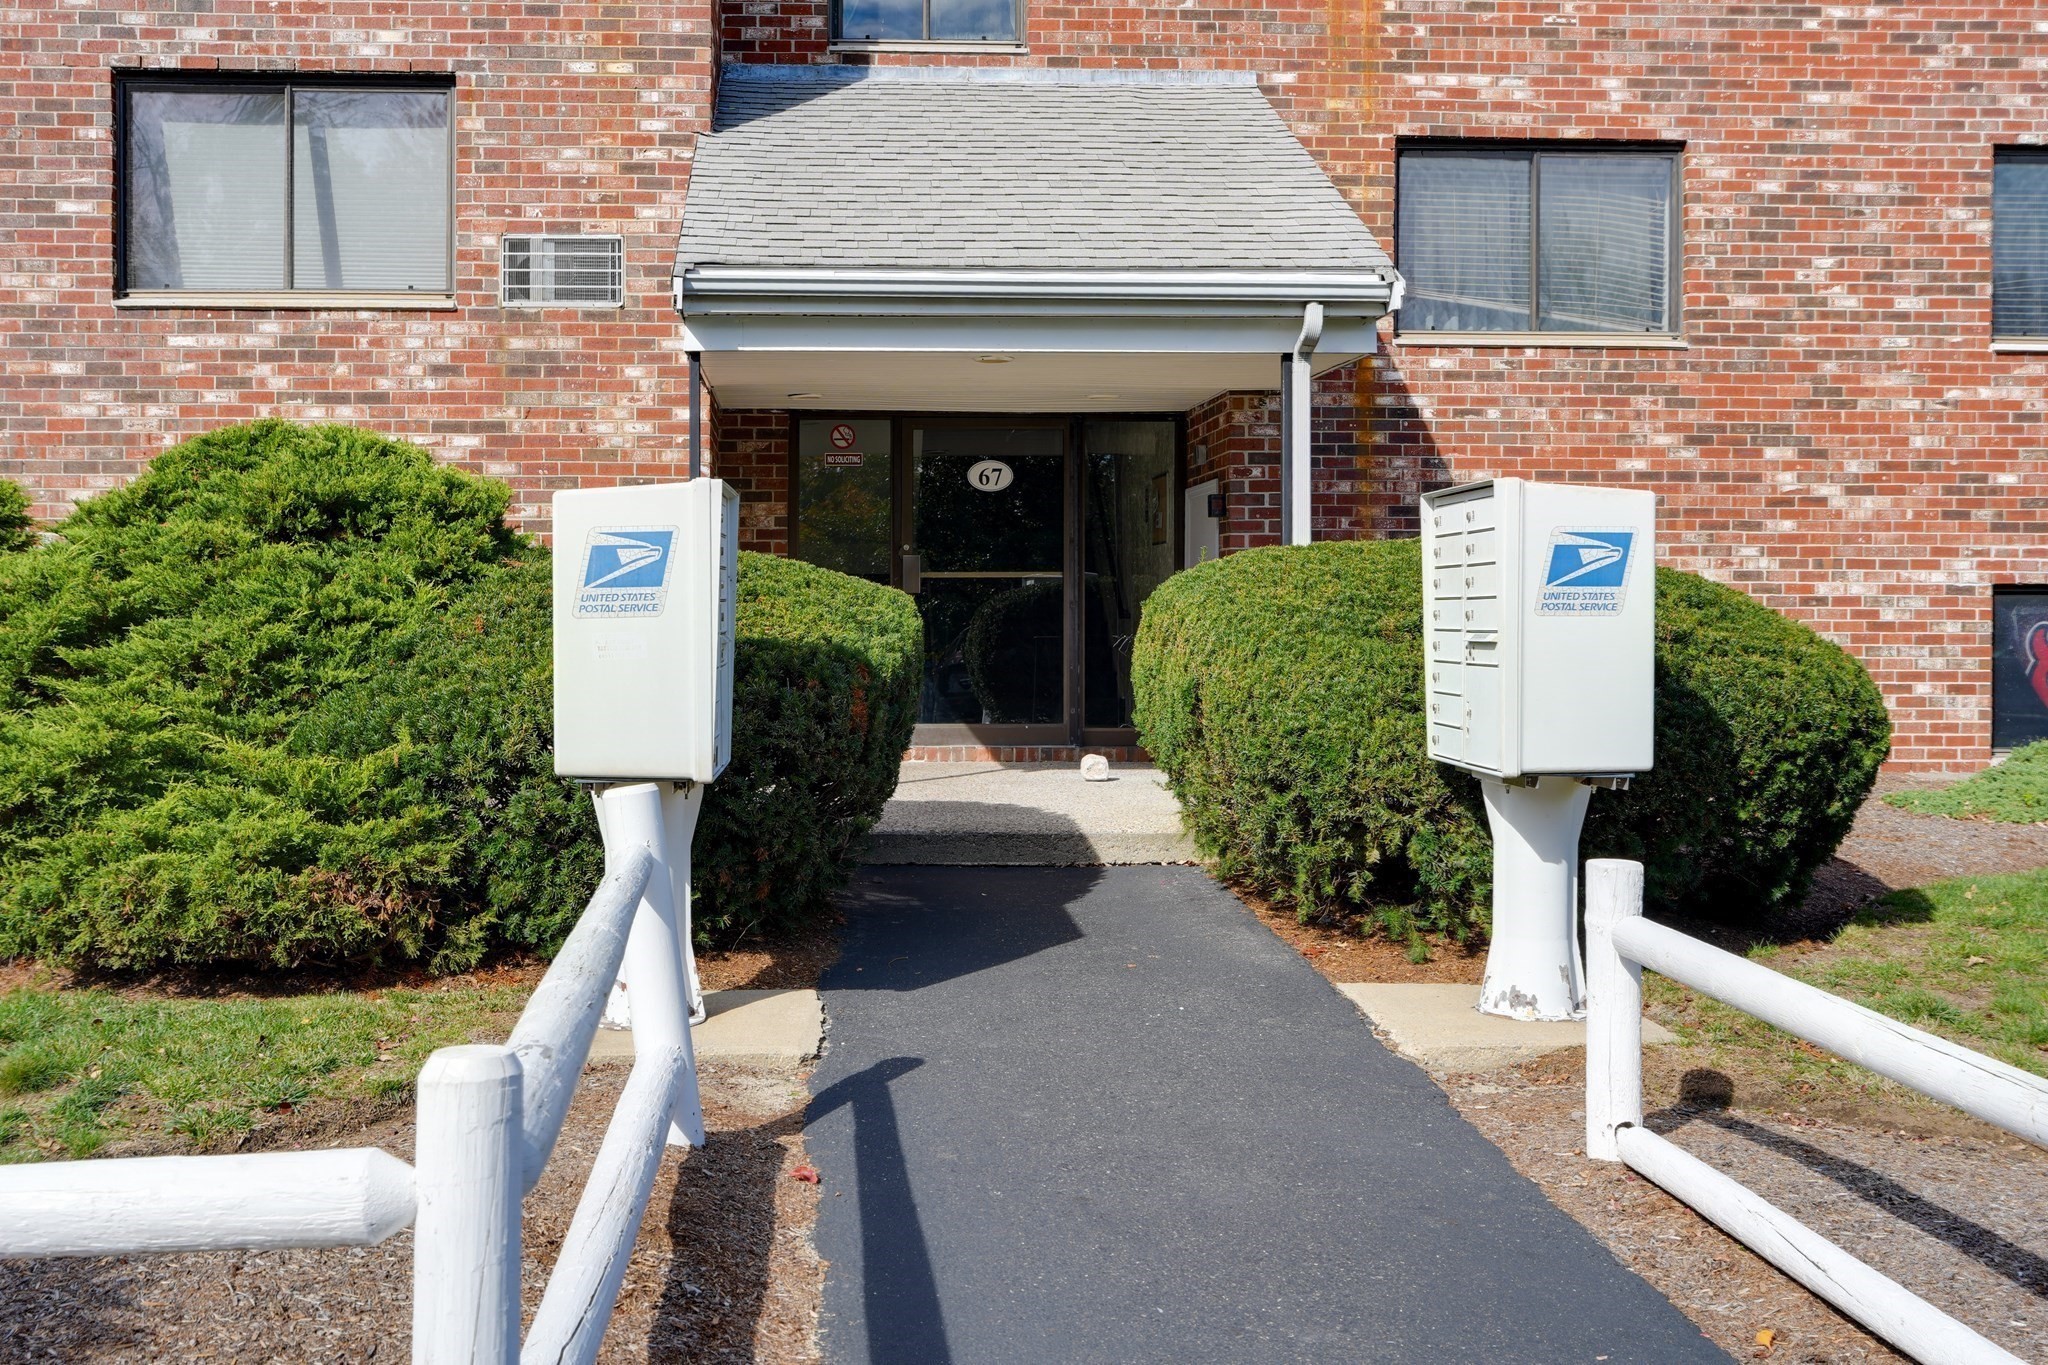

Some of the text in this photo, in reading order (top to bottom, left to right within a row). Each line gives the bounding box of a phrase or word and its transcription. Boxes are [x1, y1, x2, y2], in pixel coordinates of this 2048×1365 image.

[827, 455, 860, 463] NO SOLICITING
[978, 467, 1002, 486] 67
[581, 592, 656, 602] UNITED STATES
[1543, 592, 1615, 601] UNITED STATES
[579, 603, 659, 613] POSTAL SERVICE
[1541, 602, 1618, 611] POSTAL SERVICE
